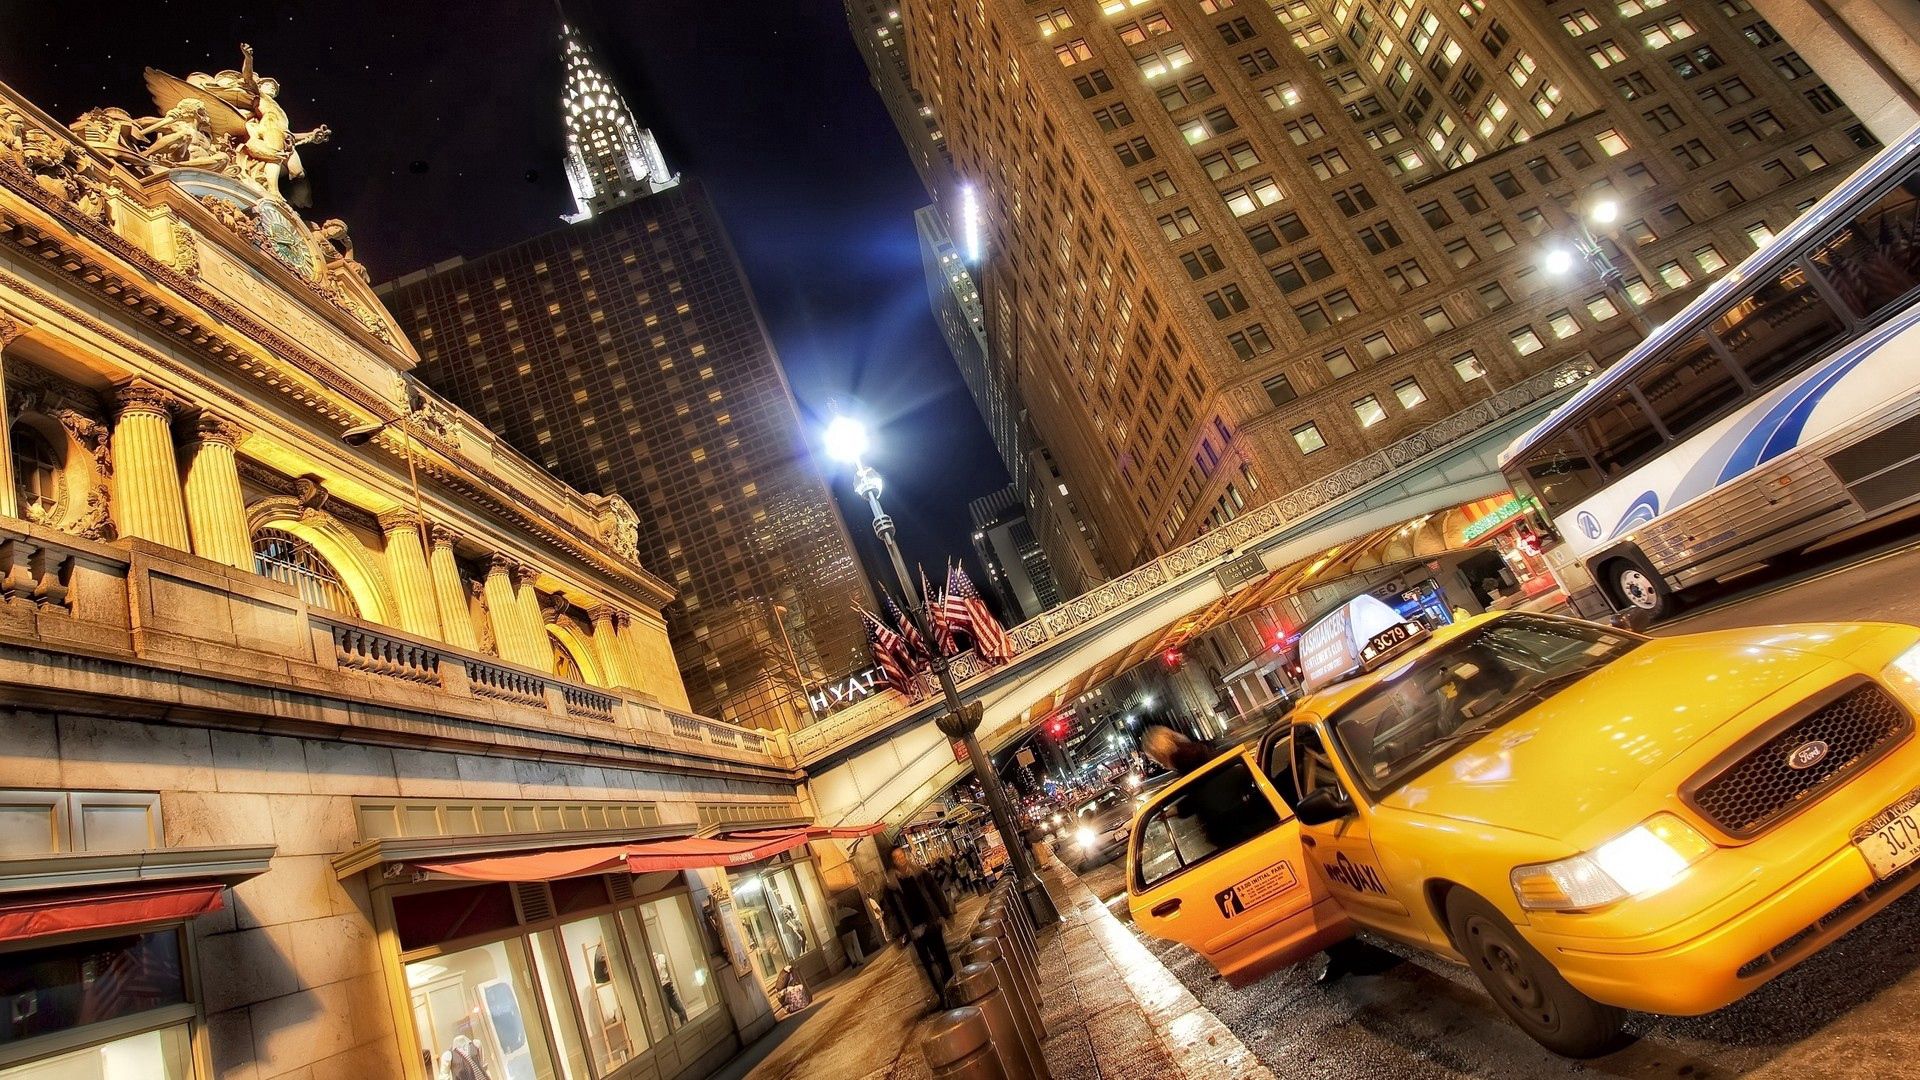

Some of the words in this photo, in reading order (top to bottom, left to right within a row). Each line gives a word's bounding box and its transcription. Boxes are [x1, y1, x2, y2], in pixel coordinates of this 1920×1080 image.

[1373, 627, 1405, 651] 3C79
[1799, 746, 1821, 764] Ford
[1872, 810, 1891, 832] NEW
[1889, 800, 1916, 818] YORK
[1879, 815, 1920, 856] 3C79
[1251, 872, 1270, 884] INITIAL
[1271, 864, 1285, 874] FARE
